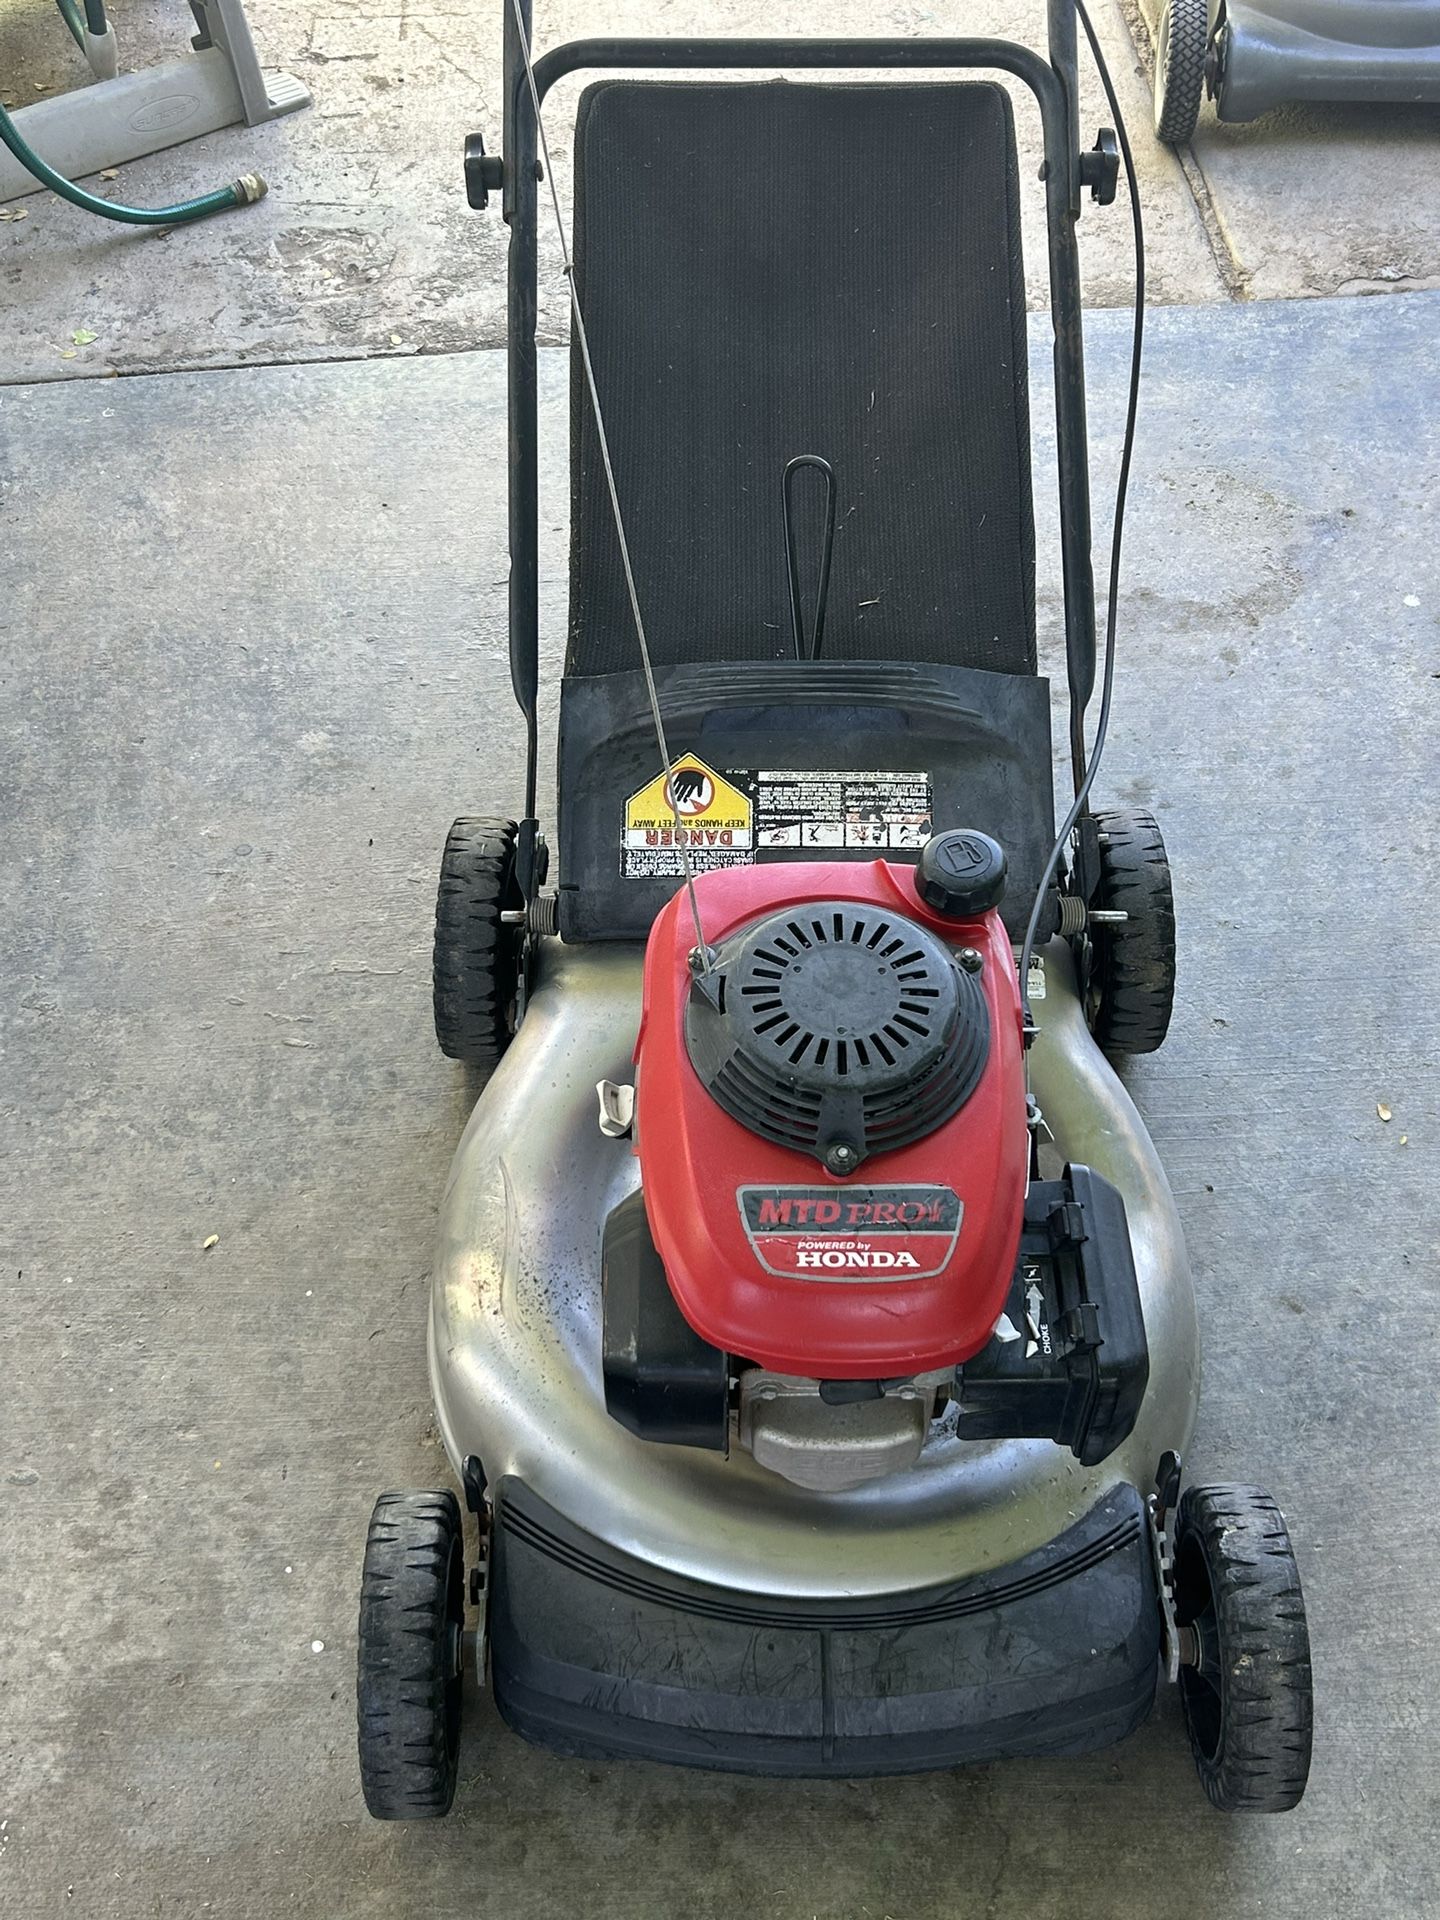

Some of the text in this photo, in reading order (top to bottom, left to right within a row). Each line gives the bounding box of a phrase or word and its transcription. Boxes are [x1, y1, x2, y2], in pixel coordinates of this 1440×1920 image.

[632, 819, 656, 827] AWAY
[658, 819, 675, 827] FEET
[695, 819, 723, 827] HANDS
[725, 819, 745, 827] KEEP
[645, 830, 733, 846] DANGER
[758, 1199, 926, 1225] MTD PRO
[797, 1241, 871, 1252] POWERED by
[796, 1251, 921, 1268] HONDA
[1041, 1323, 1051, 1355] CHOKE
